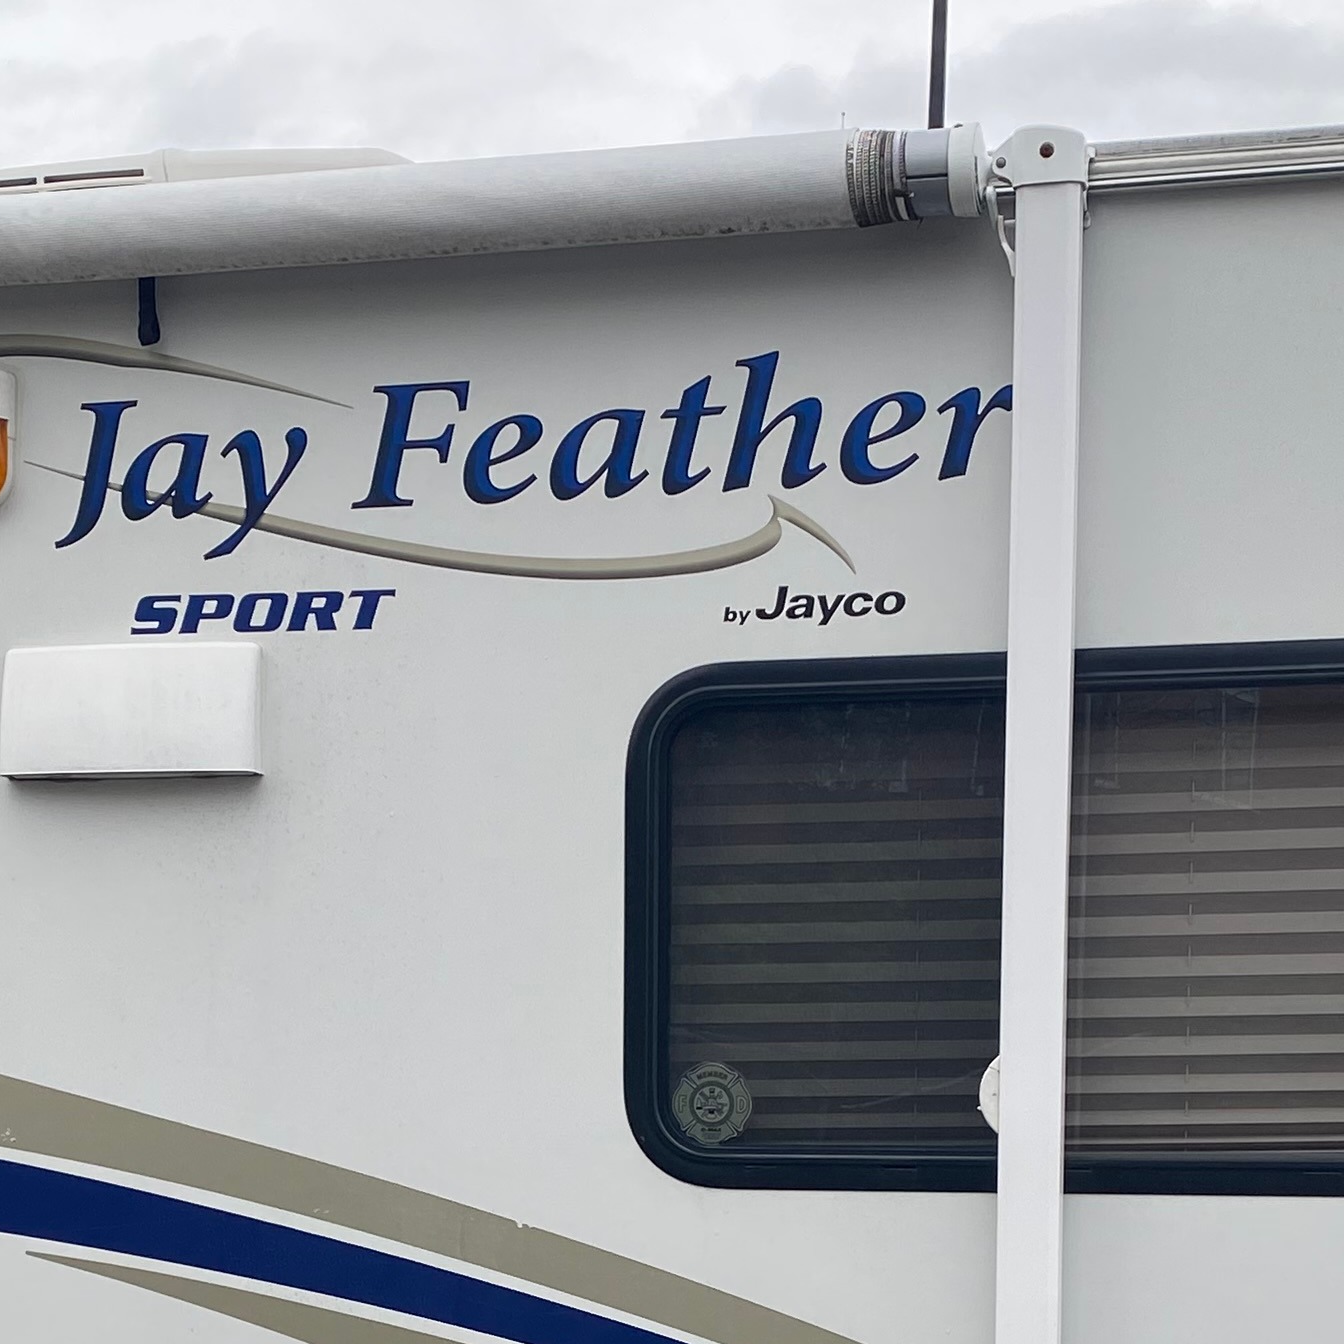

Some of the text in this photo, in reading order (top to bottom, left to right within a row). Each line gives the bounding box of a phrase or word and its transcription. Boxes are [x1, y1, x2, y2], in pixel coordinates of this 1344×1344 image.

[54, 350, 1013, 561] Jay Feather
[130, 588, 397, 635] SPORT
[723, 585, 906, 627] by Jayco
